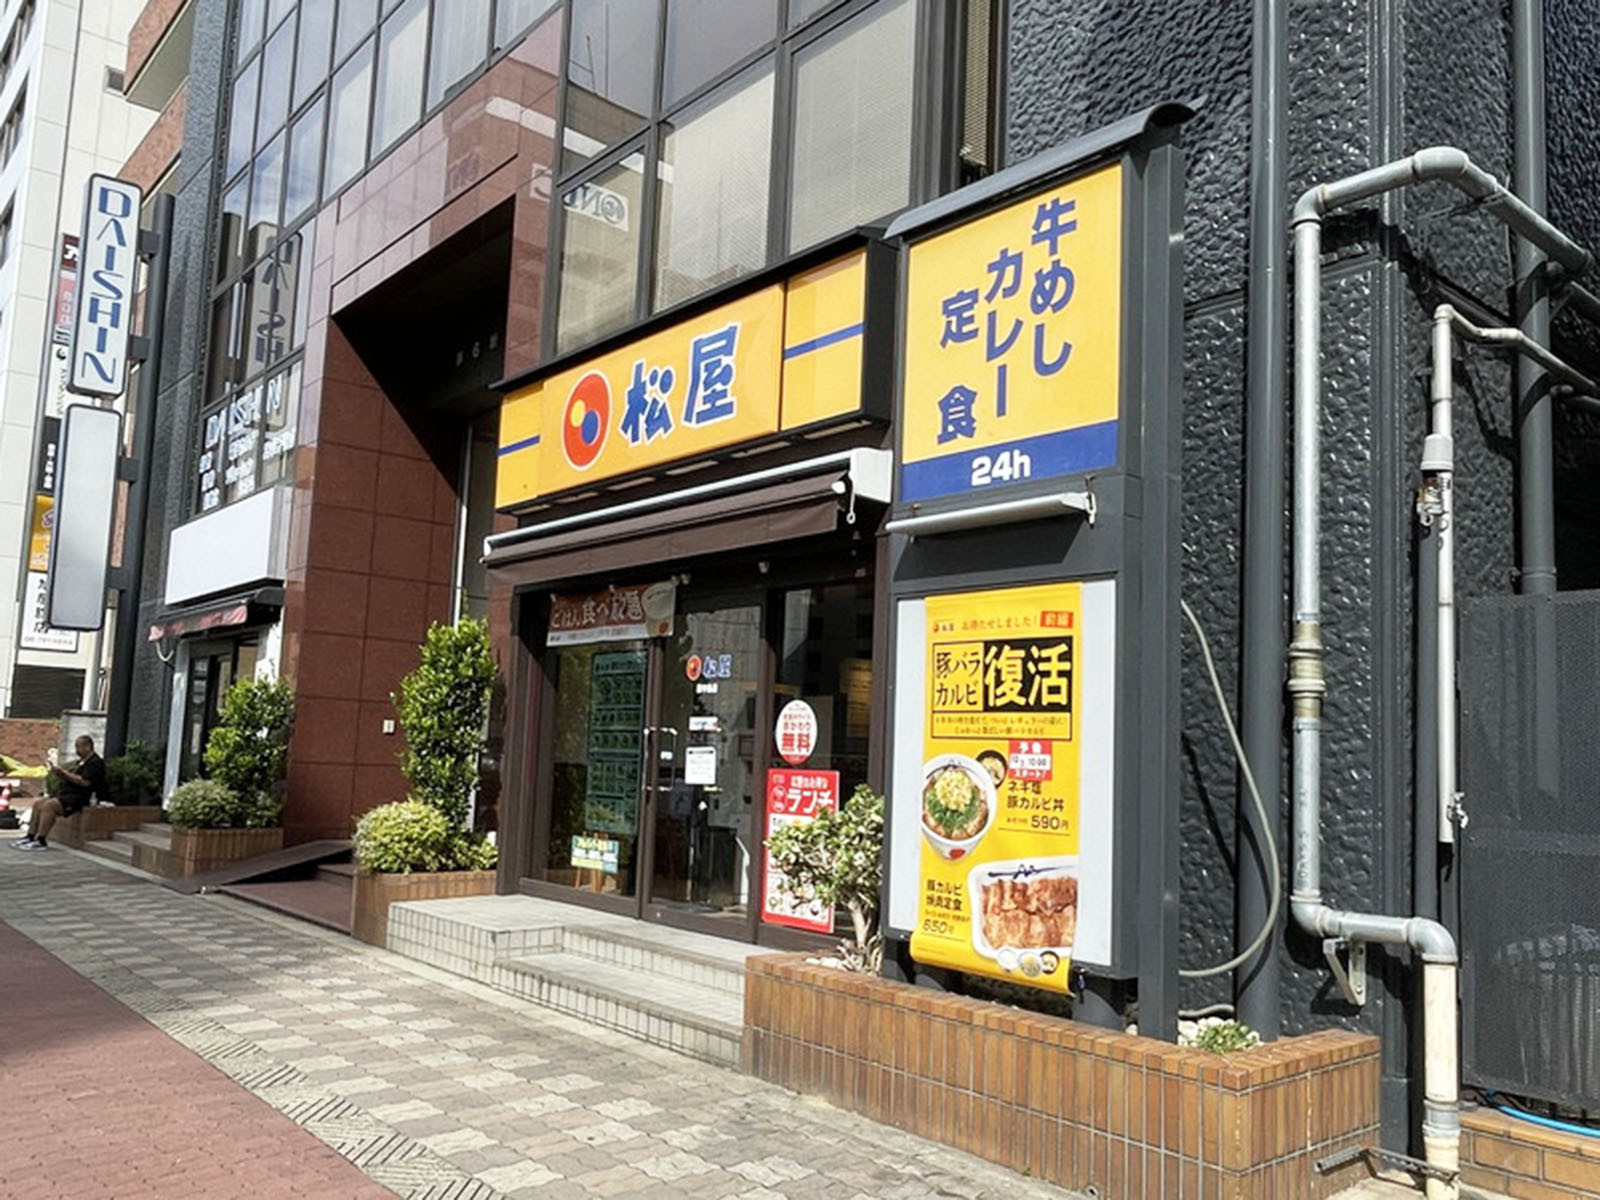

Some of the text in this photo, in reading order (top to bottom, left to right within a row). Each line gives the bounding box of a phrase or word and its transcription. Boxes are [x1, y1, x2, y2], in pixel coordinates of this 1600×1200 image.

[82, 186, 132, 384] DAISHIN
[1031, 198, 1077, 376] 牛めし
[985, 248, 1023, 417] カレー
[619, 321, 742, 445] 松屋
[937, 289, 979, 445] 定食
[971, 450, 1032, 486] 24h
[936, 652, 980, 679] 豚バラ
[984, 643, 1071, 707] 復活
[936, 680, 978, 706] カルビ
[787, 788, 833, 813] ランチ
[1008, 796, 1064, 813] 豚カルビ丼
[1031, 815, 1069, 831] 590円
